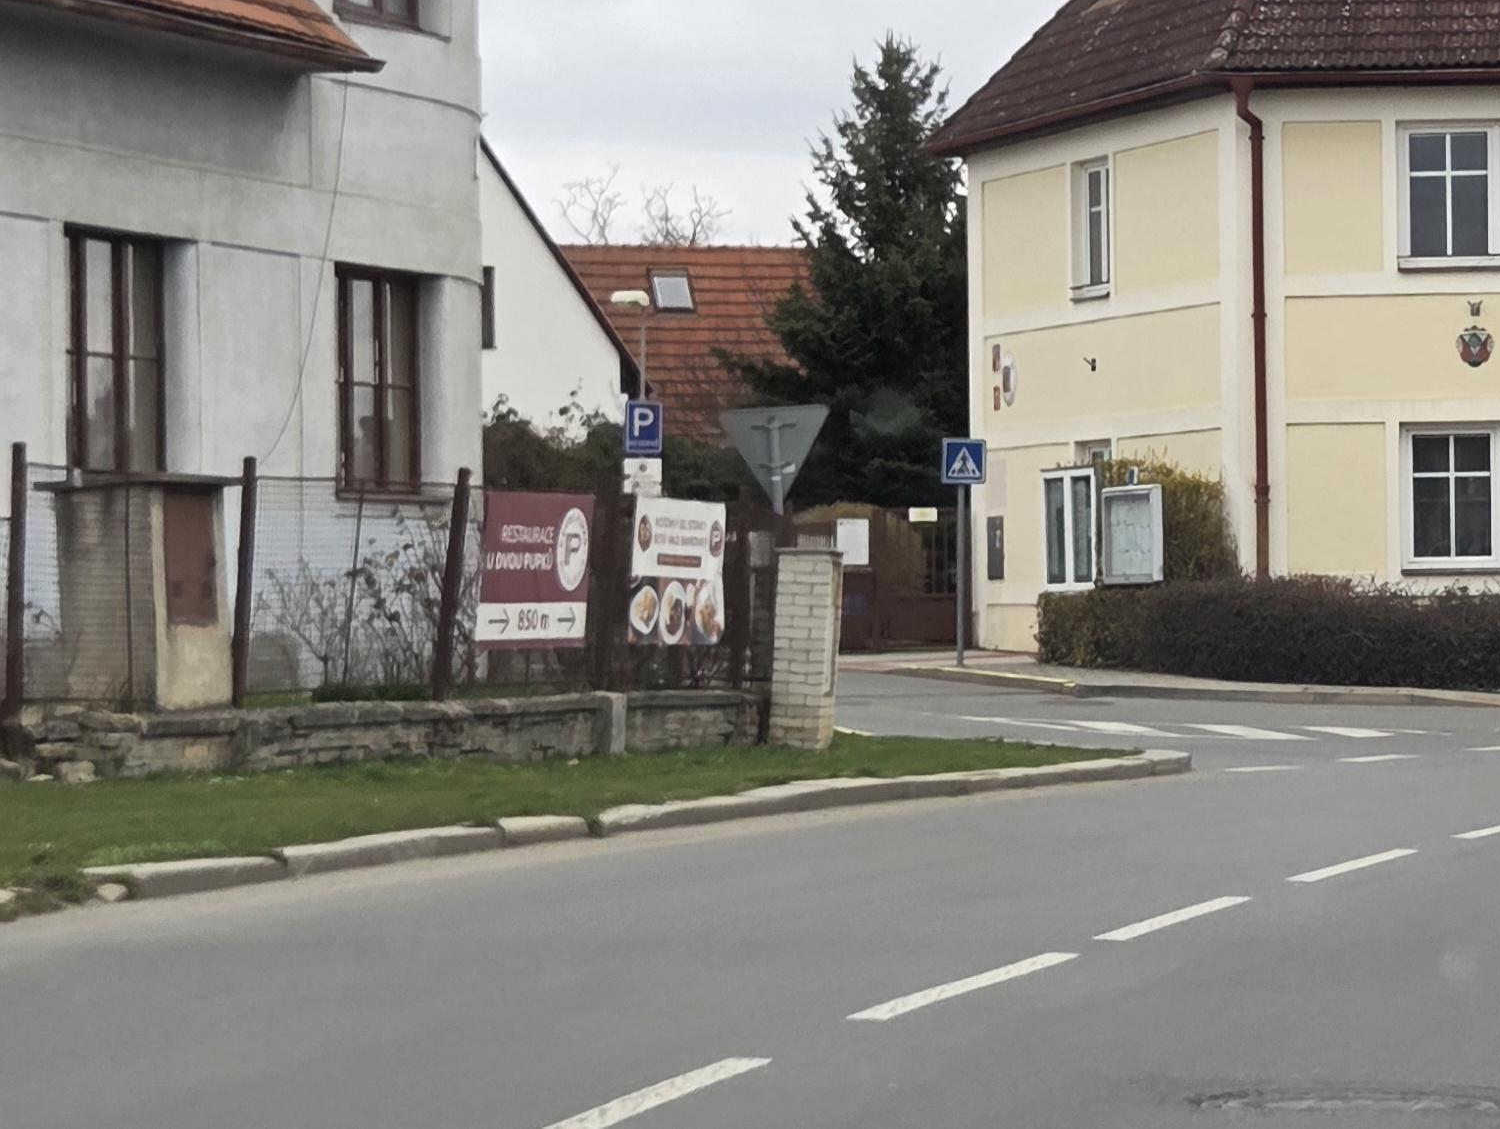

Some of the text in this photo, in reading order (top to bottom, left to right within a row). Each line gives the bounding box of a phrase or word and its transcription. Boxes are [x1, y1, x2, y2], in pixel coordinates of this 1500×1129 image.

[633, 407, 654, 437] P
[502, 524, 555, 544] RESTAURACE
[487, 552, 495, 570] U
[495, 551, 522, 570] DVOU
[517, 609, 550, 631] 850 m
